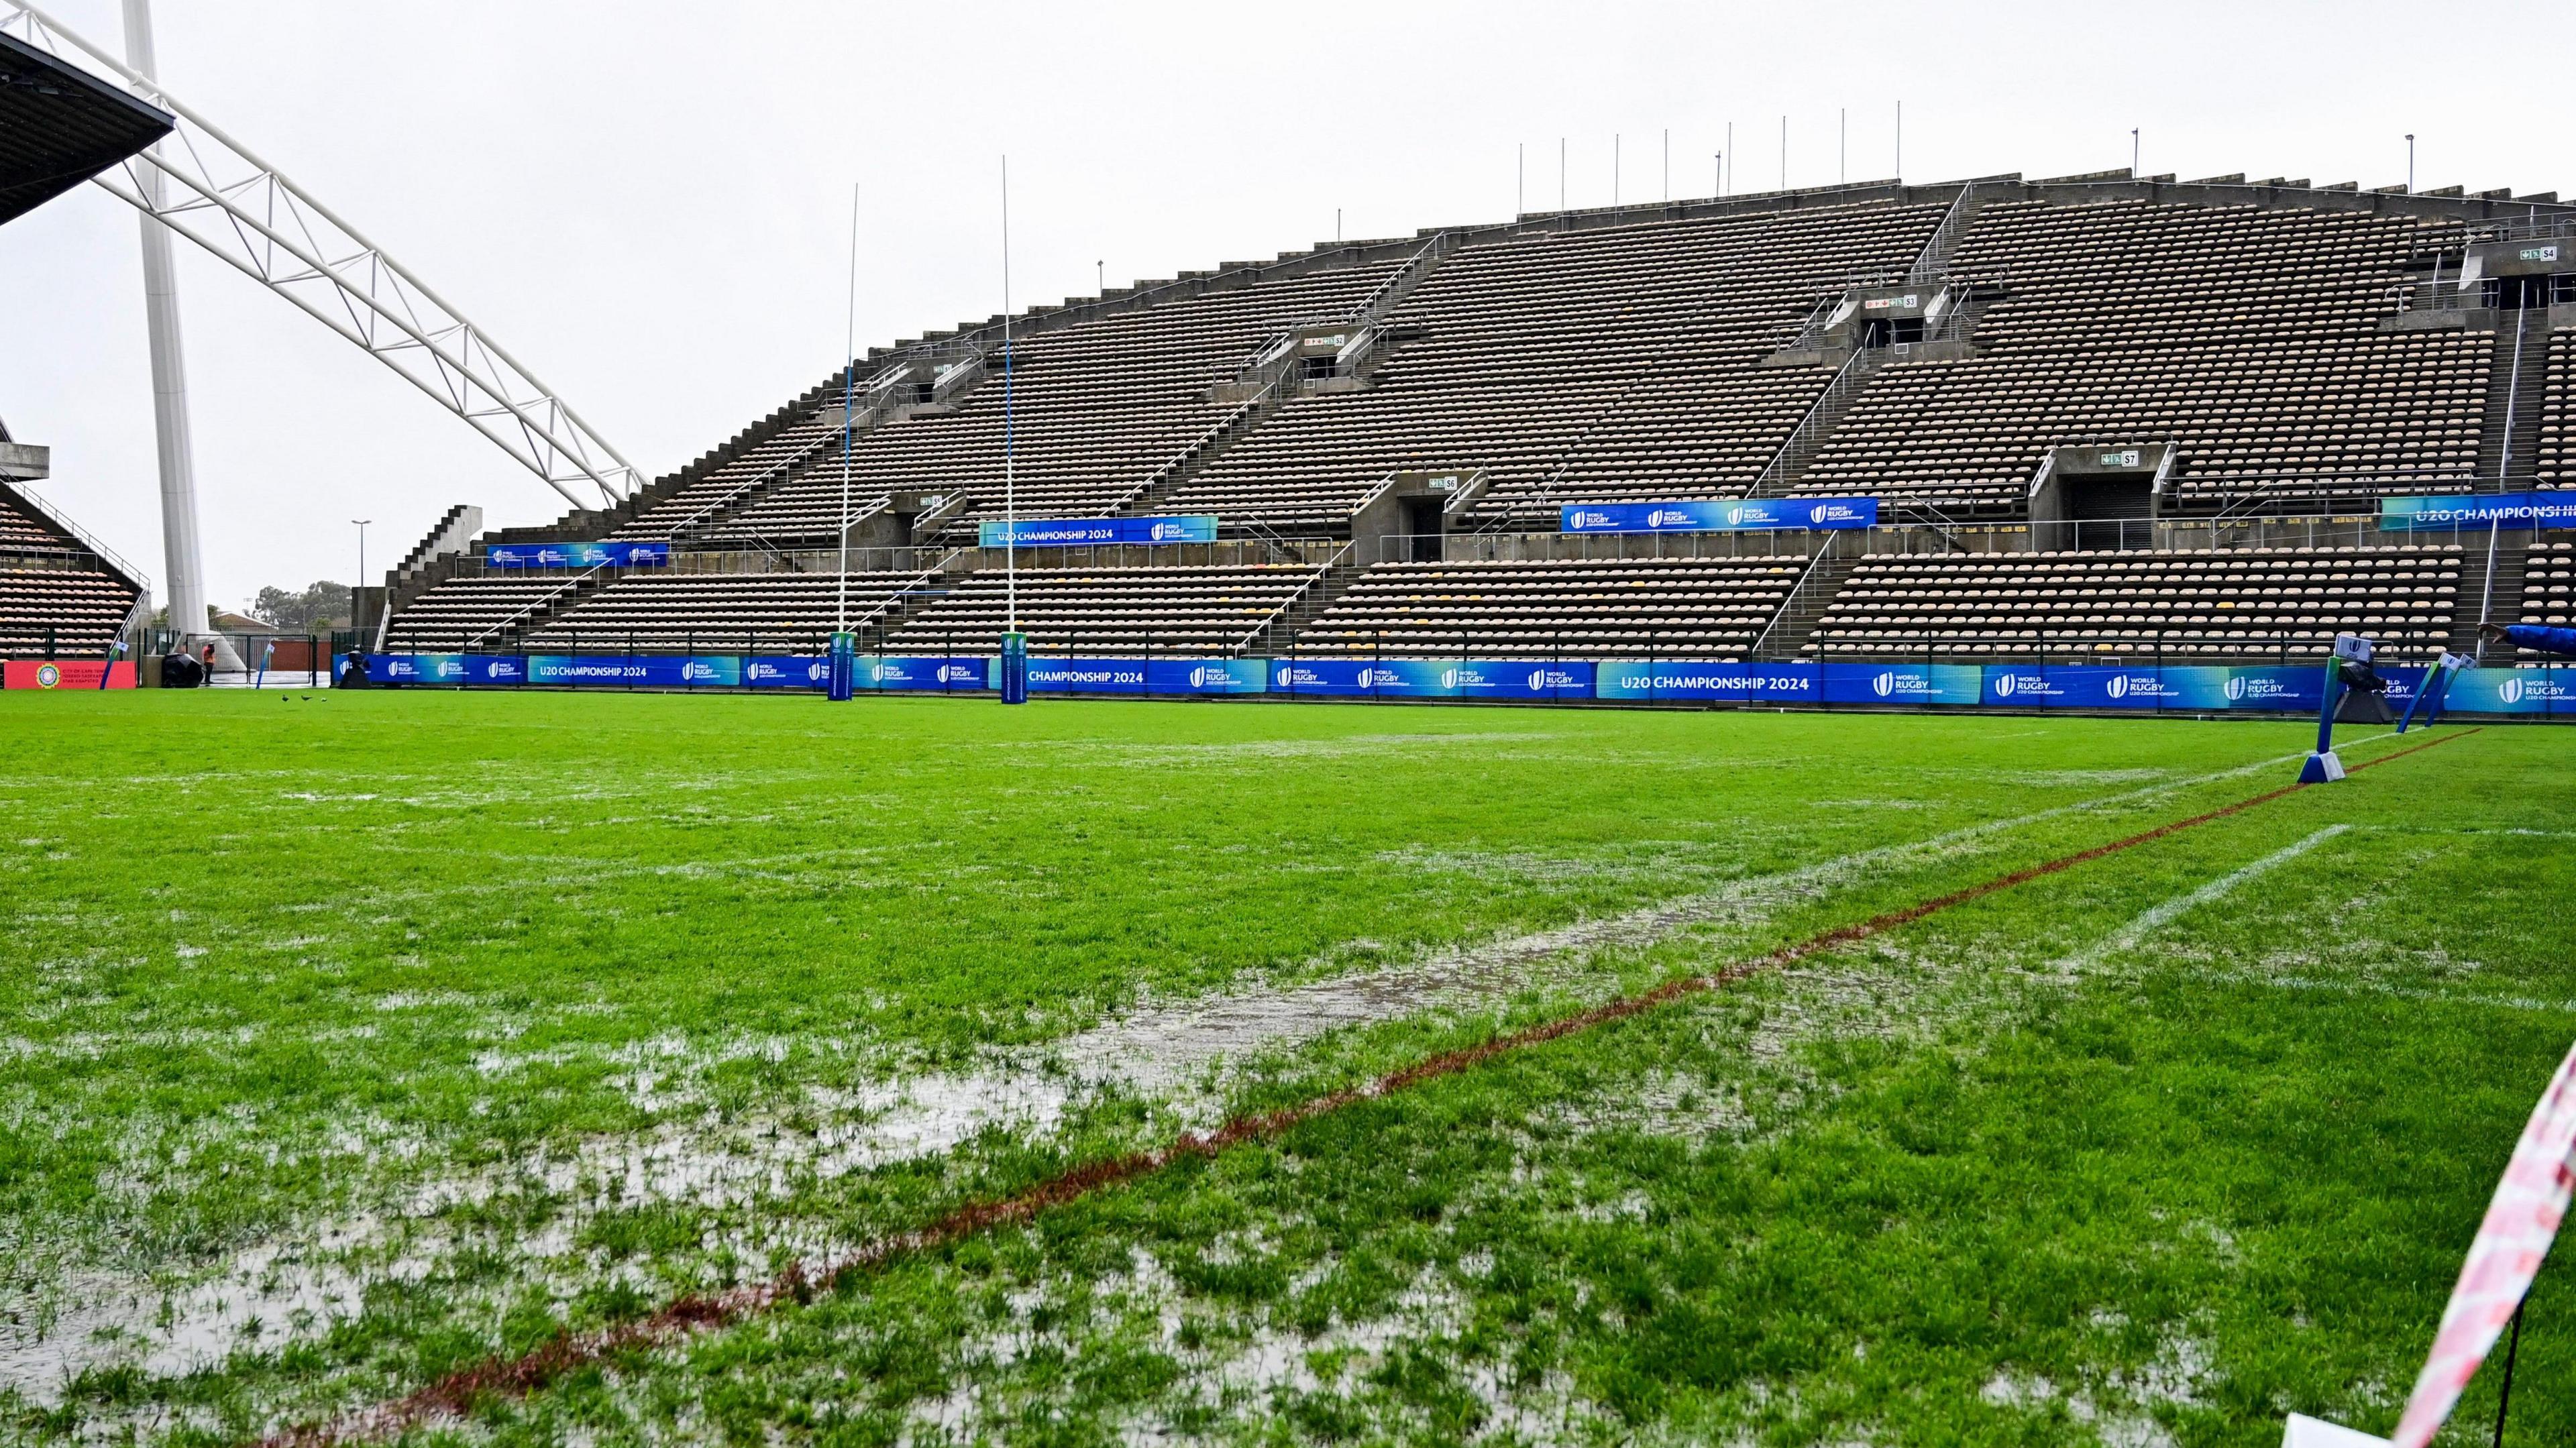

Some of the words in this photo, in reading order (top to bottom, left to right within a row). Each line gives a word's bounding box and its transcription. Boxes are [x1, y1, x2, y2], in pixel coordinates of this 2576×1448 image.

[2544, 249, 2553, 258] S4
[2125, 455, 2135, 463] S7
[2416, 510, 2451, 522] U20
[998, 533, 1016, 541] U20
[1018, 531, 1086, 541] CHAMPIONSHIP
[1088, 530, 1112, 539] 2024
[540, 667, 557, 676] U20
[559, 667, 622, 677] CHAMPIONSHIP
[624, 667, 647, 677] 2024
[1028, 671, 1112, 683] CHAMPIONSHIP
[1114, 672, 1143, 683] 2024
[1621, 677, 1651, 689] U20
[1654, 677, 1766, 690] CHAMPIONSHIP
[1768, 677, 1809, 690] 2024
[1896, 680, 1929, 689] RUGBY
[2018, 682, 2050, 690] RUGBY
[2130, 683, 2165, 691] RUGBY
[2248, 685, 2284, 693] RUGBY
[2525, 687, 2565, 695] RUGBY
